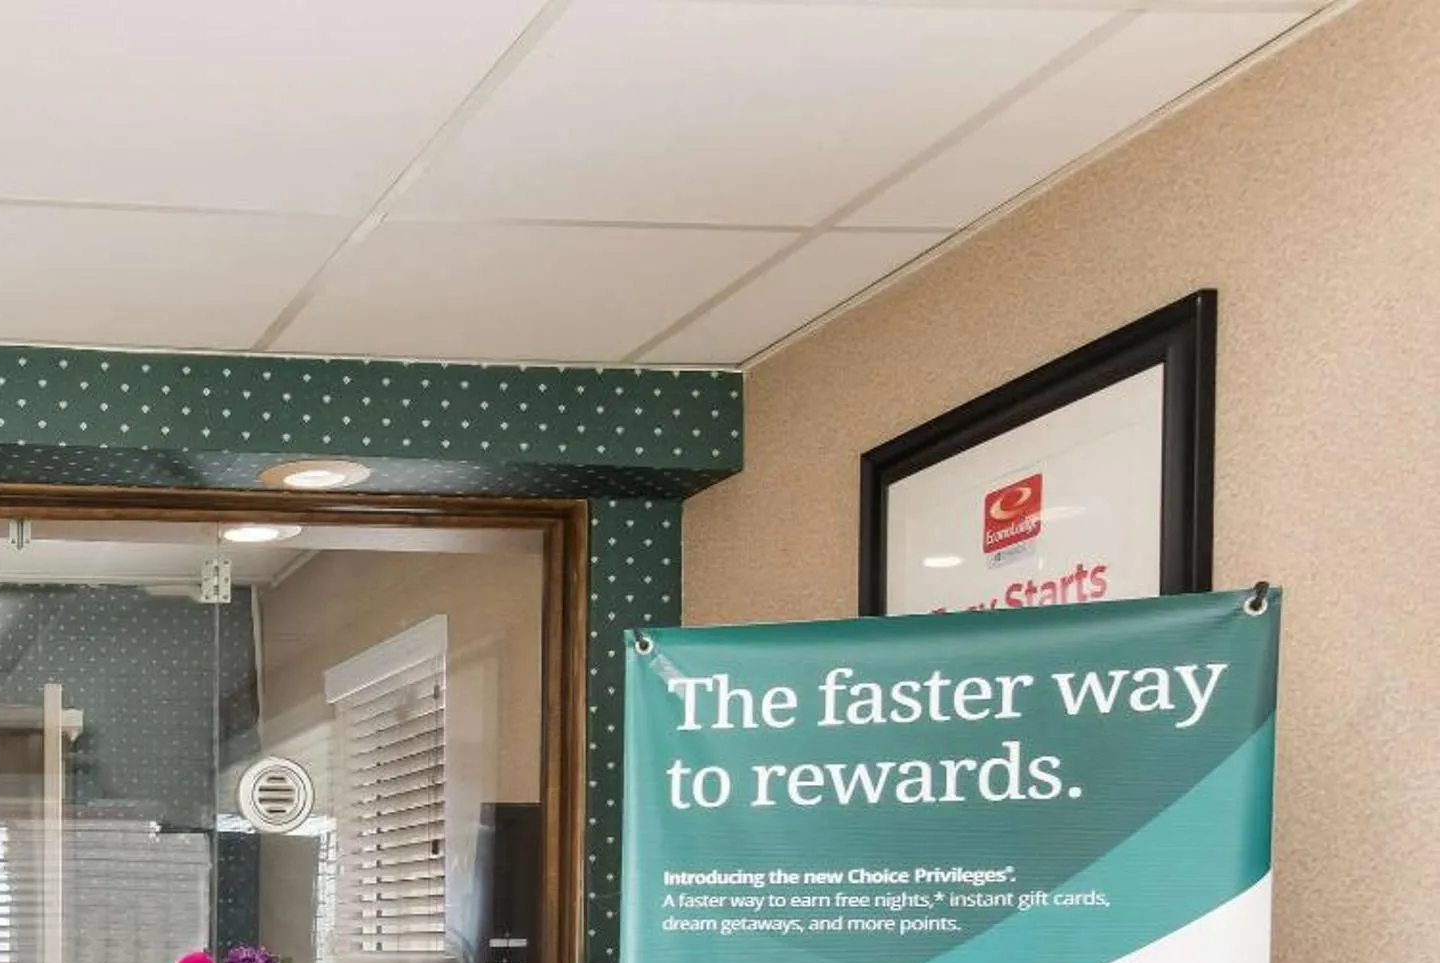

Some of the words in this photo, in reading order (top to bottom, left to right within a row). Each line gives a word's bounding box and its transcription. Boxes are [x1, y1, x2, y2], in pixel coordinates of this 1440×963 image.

[1005, 563, 1108, 608] Starts
[668, 674, 798, 731] The
[817, 667, 1033, 727] faster
[1052, 661, 1228, 728] way
[666, 757, 732, 809] to
[750, 741, 1083, 806] rewards.
[663, 868, 765, 888] Introducing
[768, 868, 800, 885] the
[803, 871, 844, 885] new
[847, 868, 910, 884] Choice
[662, 894, 675, 908] A
[678, 892, 726, 908] faster
[729, 895, 765, 912] way
[768, 894, 786, 907] to
[790, 895, 831, 907] earn
[834, 892, 871, 907] free
[950, 892, 1015, 907] instant
[1017, 890, 1049, 912] gift
[1053, 889, 1111, 908] cards,
[662, 915, 717, 931] dream
[720, 917, 804, 936] getaways,
[808, 916, 844, 931] and
[847, 918, 896, 931] more
[900, 915, 962, 936] points.
